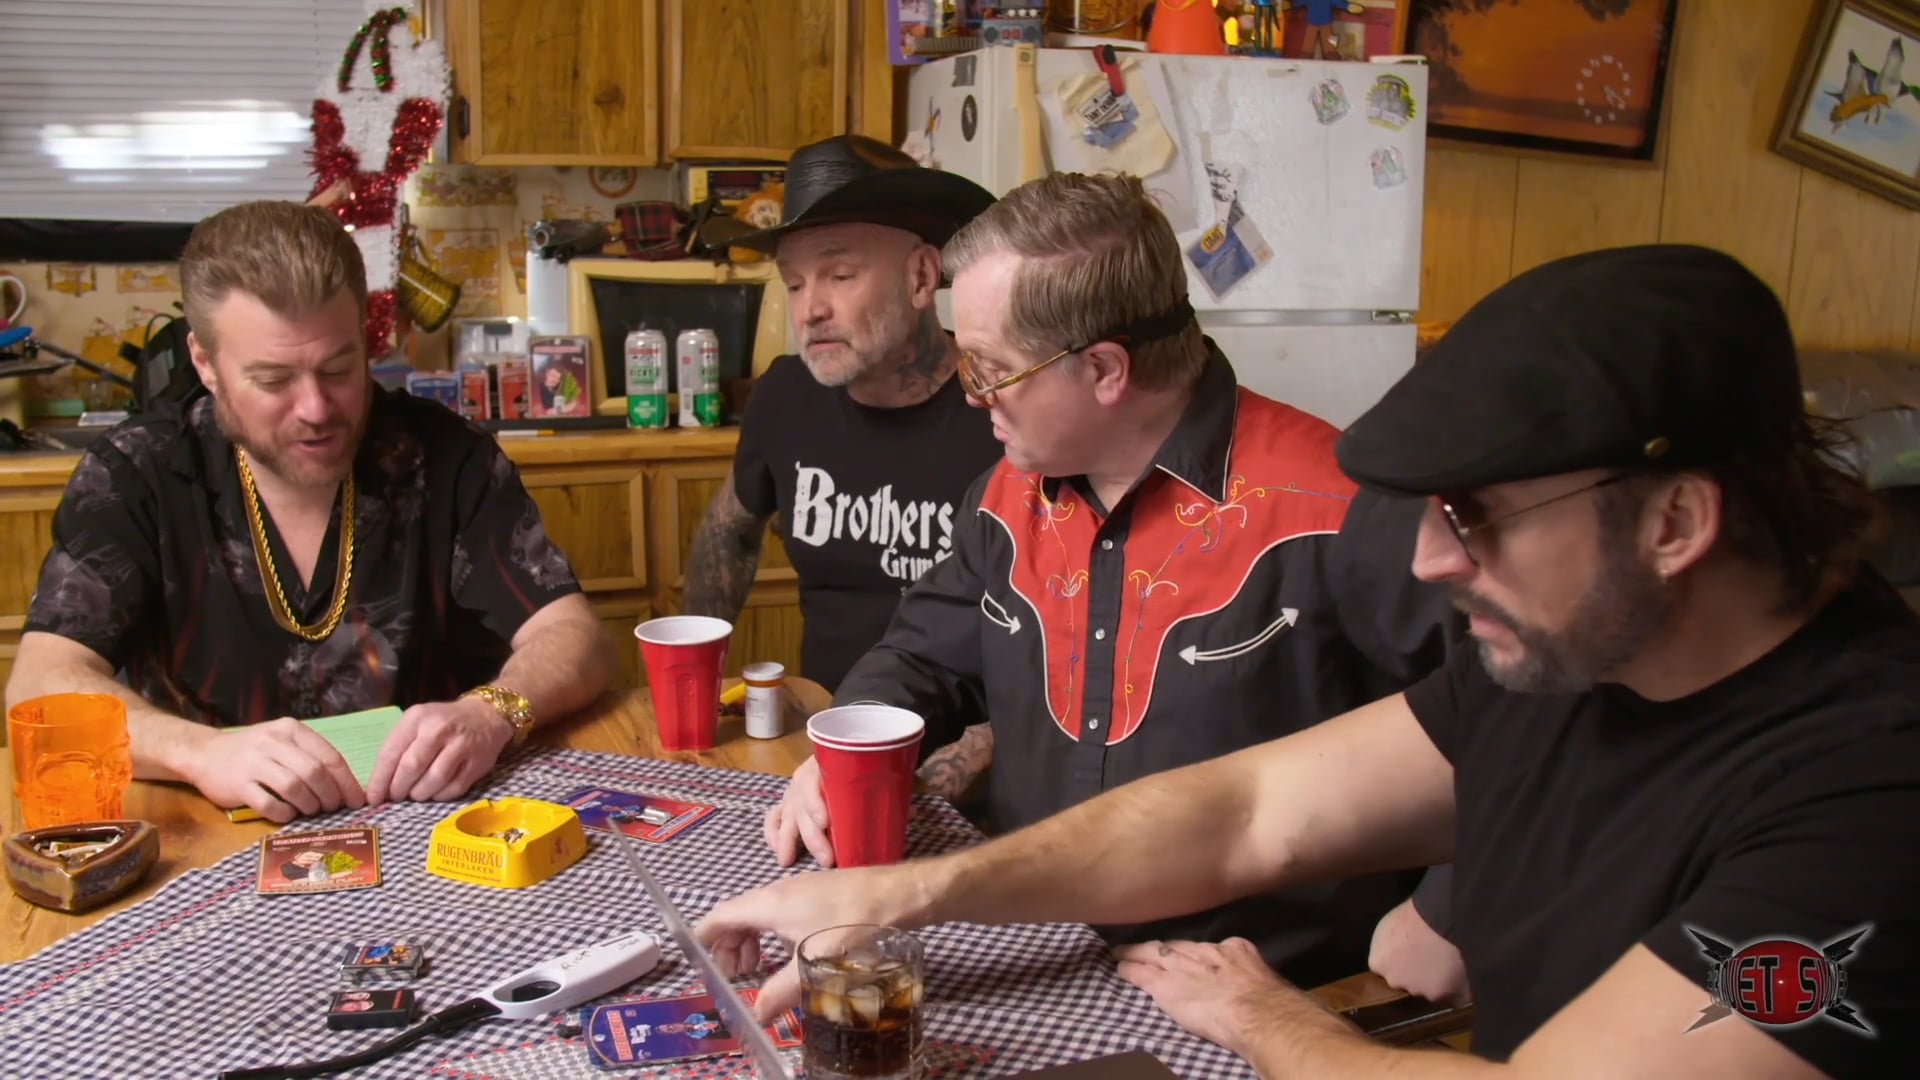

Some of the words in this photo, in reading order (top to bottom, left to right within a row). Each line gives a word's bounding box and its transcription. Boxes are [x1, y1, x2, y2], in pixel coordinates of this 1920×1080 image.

[792, 461, 954, 549] Brothers
[436, 842, 504, 868] RUGENBRÄU
[441, 858, 495, 874] INTERLAKEN
